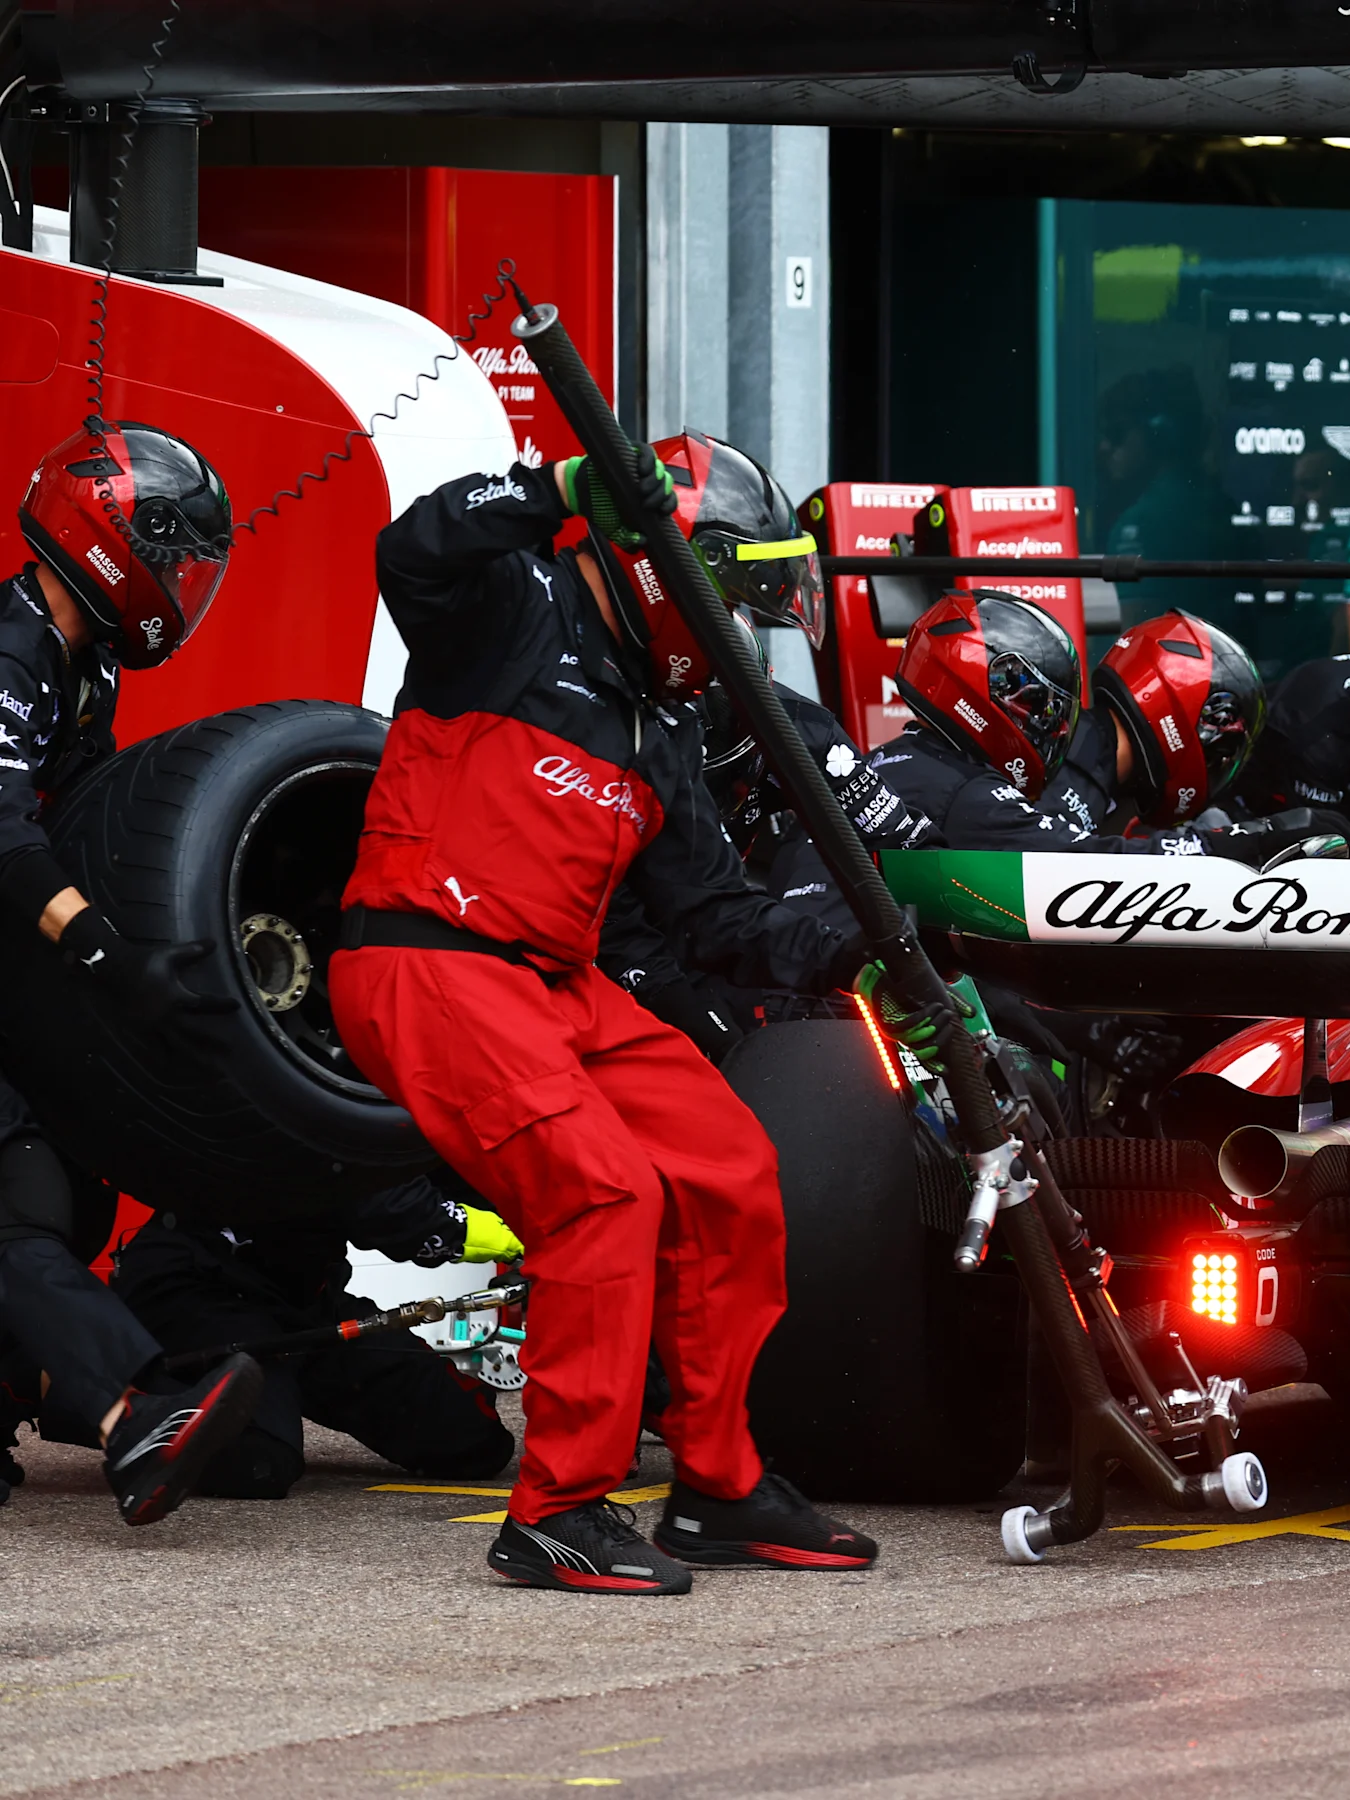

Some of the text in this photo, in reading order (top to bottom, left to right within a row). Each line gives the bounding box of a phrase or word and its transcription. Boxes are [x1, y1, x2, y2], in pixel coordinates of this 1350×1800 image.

[793, 265, 805, 299] 9
[509, 386, 535, 401] TEAM
[466, 475, 527, 510] Stake
[970, 488, 1056, 511] PIRELLI
[86, 550, 118, 586] WORKWEAR
[91, 545, 125, 581] MASCOT
[640, 559, 664, 601] MASCOT
[633, 562, 656, 605] WORKWEAR
[140, 616, 161, 651] Stake
[666, 654, 692, 688] Stake
[953, 704, 984, 733] WORKWEAR
[956, 698, 989, 728] MASCOT
[1165, 715, 1184, 750] MASCOT
[533, 755, 598, 796] Alfa
[1005, 757, 1028, 789] Stake
[1178, 787, 1197, 814] Stak
[1160, 835, 1203, 856] Stak
[1045, 879, 1221, 944] Alfa
[1256, 1248, 1276, 1261] CODE
